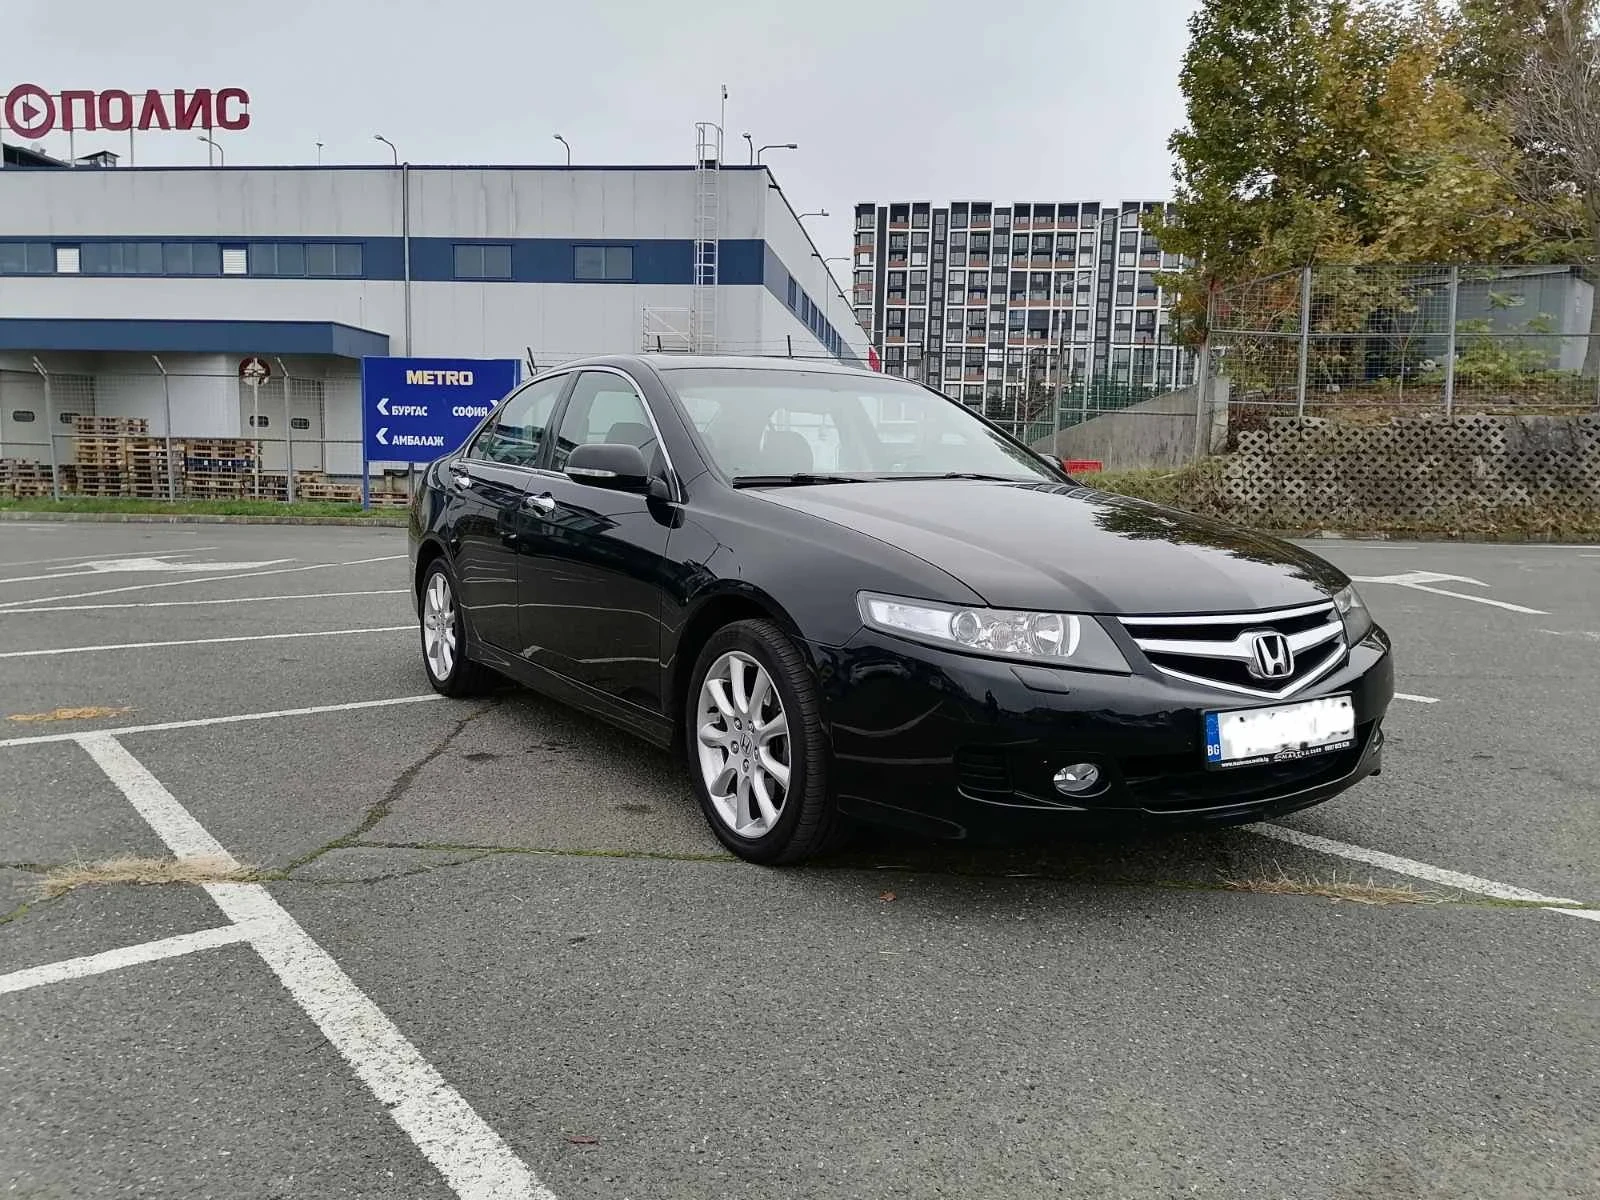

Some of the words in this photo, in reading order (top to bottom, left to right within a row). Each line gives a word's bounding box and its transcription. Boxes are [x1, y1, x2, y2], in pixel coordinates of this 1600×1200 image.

[406, 370, 474, 386] METRO
[391, 405, 428, 417] БУРГАС
[452, 406, 488, 418] СОФИЯ
[392, 435, 444, 447] АМБАЛАЖ
[1207, 744, 1220, 757] BG
